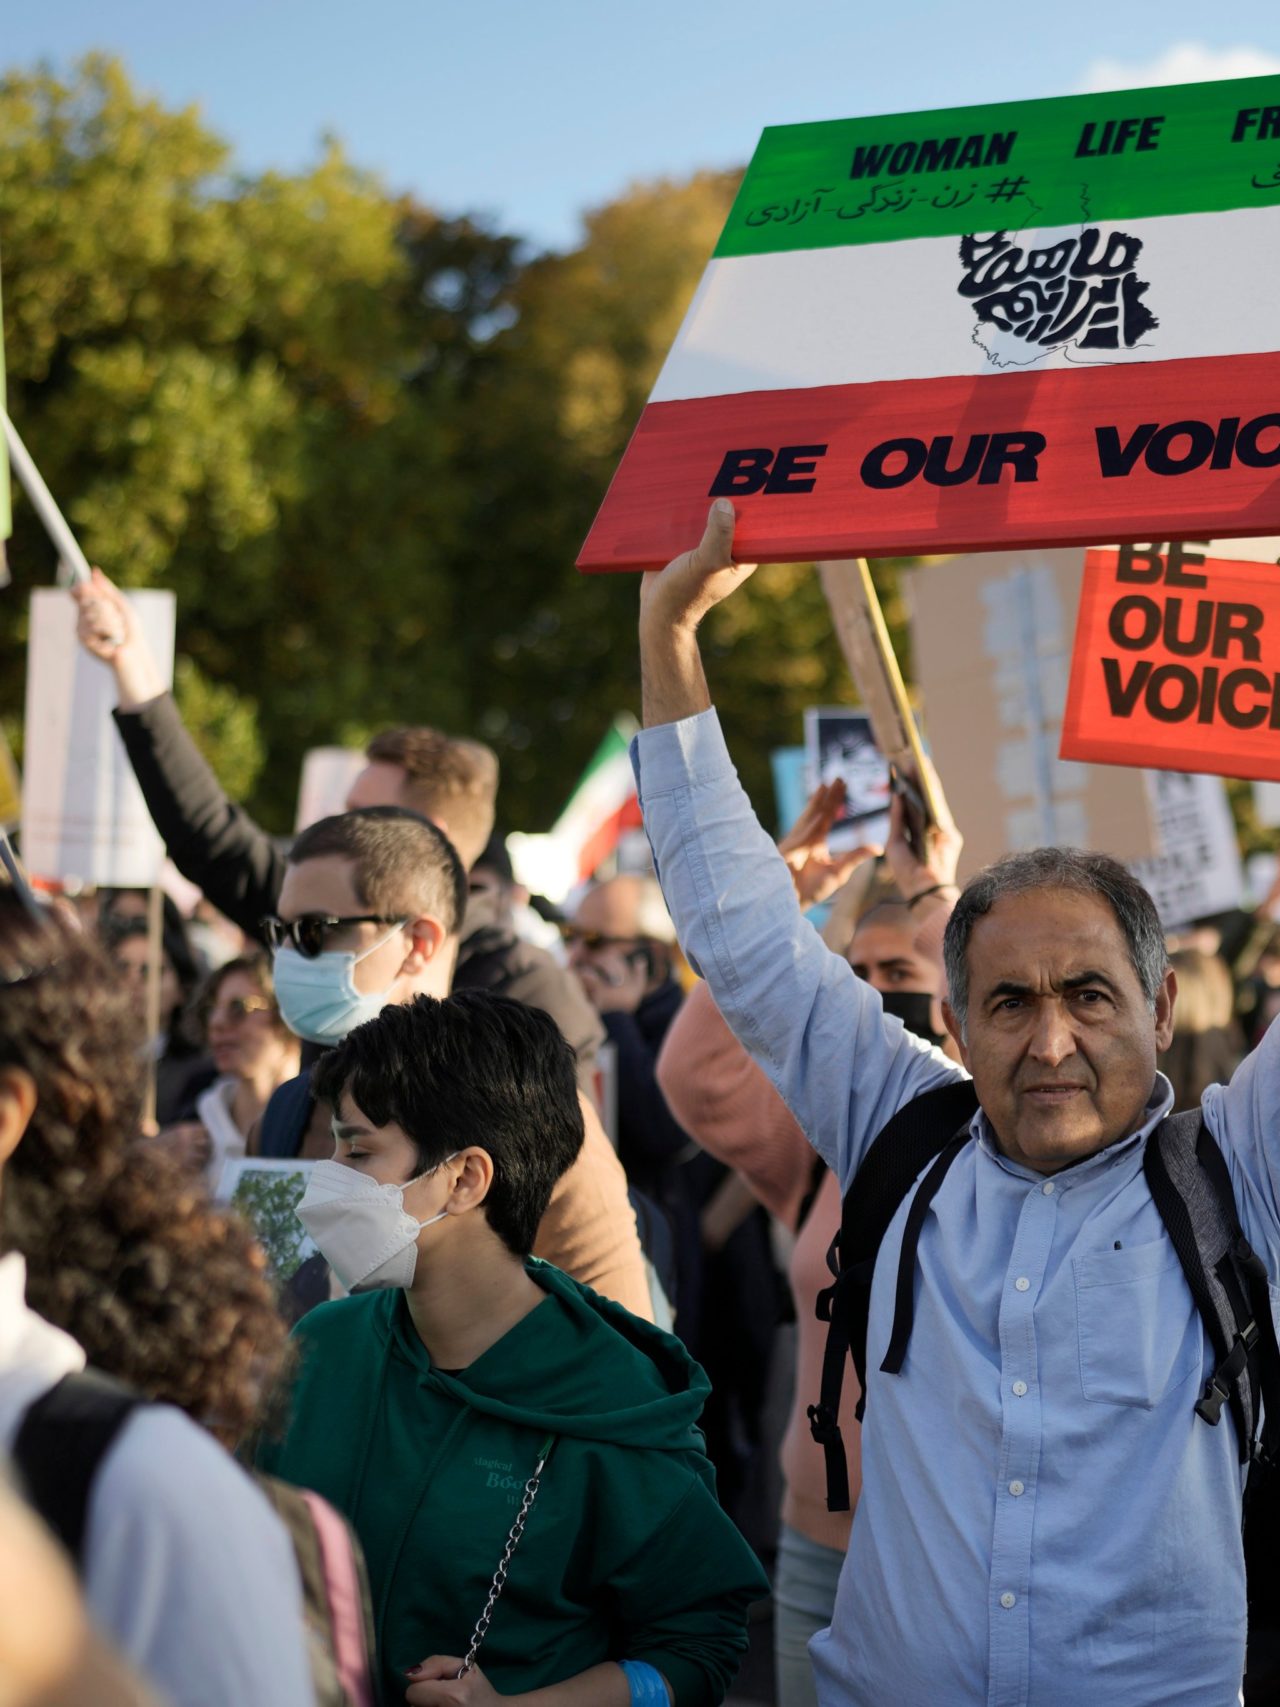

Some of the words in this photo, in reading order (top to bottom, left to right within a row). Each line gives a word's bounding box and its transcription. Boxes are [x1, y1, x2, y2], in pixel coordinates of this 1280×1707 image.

[848, 130, 1018, 181] WOMAN
[1073, 115, 1166, 159] LIFE
[708, 443, 828, 497] BE
[859, 430, 1047, 490] OUR
[1115, 541, 1210, 590] BE
[1107, 595, 1264, 662] OUR
